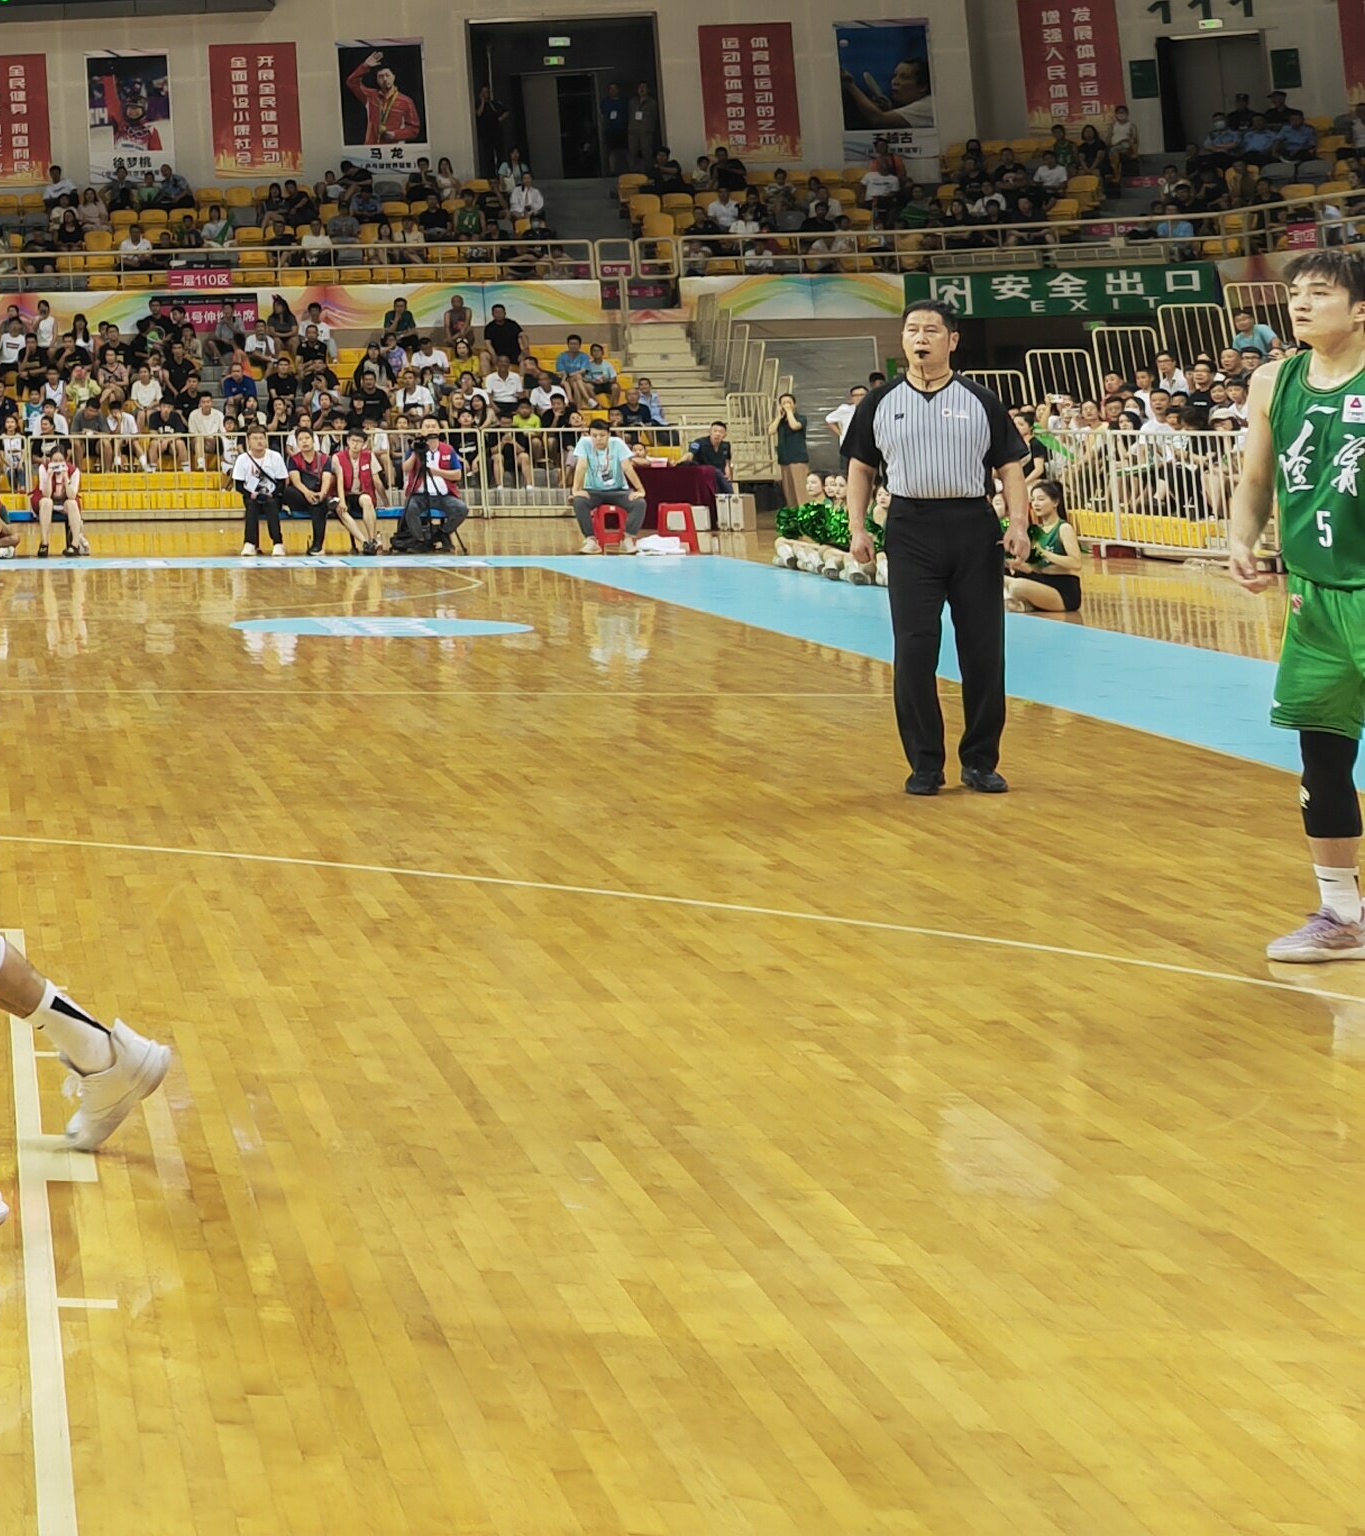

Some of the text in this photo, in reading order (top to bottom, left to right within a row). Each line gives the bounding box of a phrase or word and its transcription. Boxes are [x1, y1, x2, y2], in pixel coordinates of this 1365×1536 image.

[1041, 10, 1069, 117] 增强人民体质
[1072, 8, 1101, 116] 发展体育运动
[8, 65, 28, 116] 全民健身
[230, 56, 252, 167] 全面建设小康社会
[257, 55, 279, 166] 开展全民健身运动
[370, 148, 404, 159] 马龙
[171, 274, 230, 286] 二层110区
[992, 270, 1200, 302] 安全出口
[1315, 510, 1333, 547] 5
